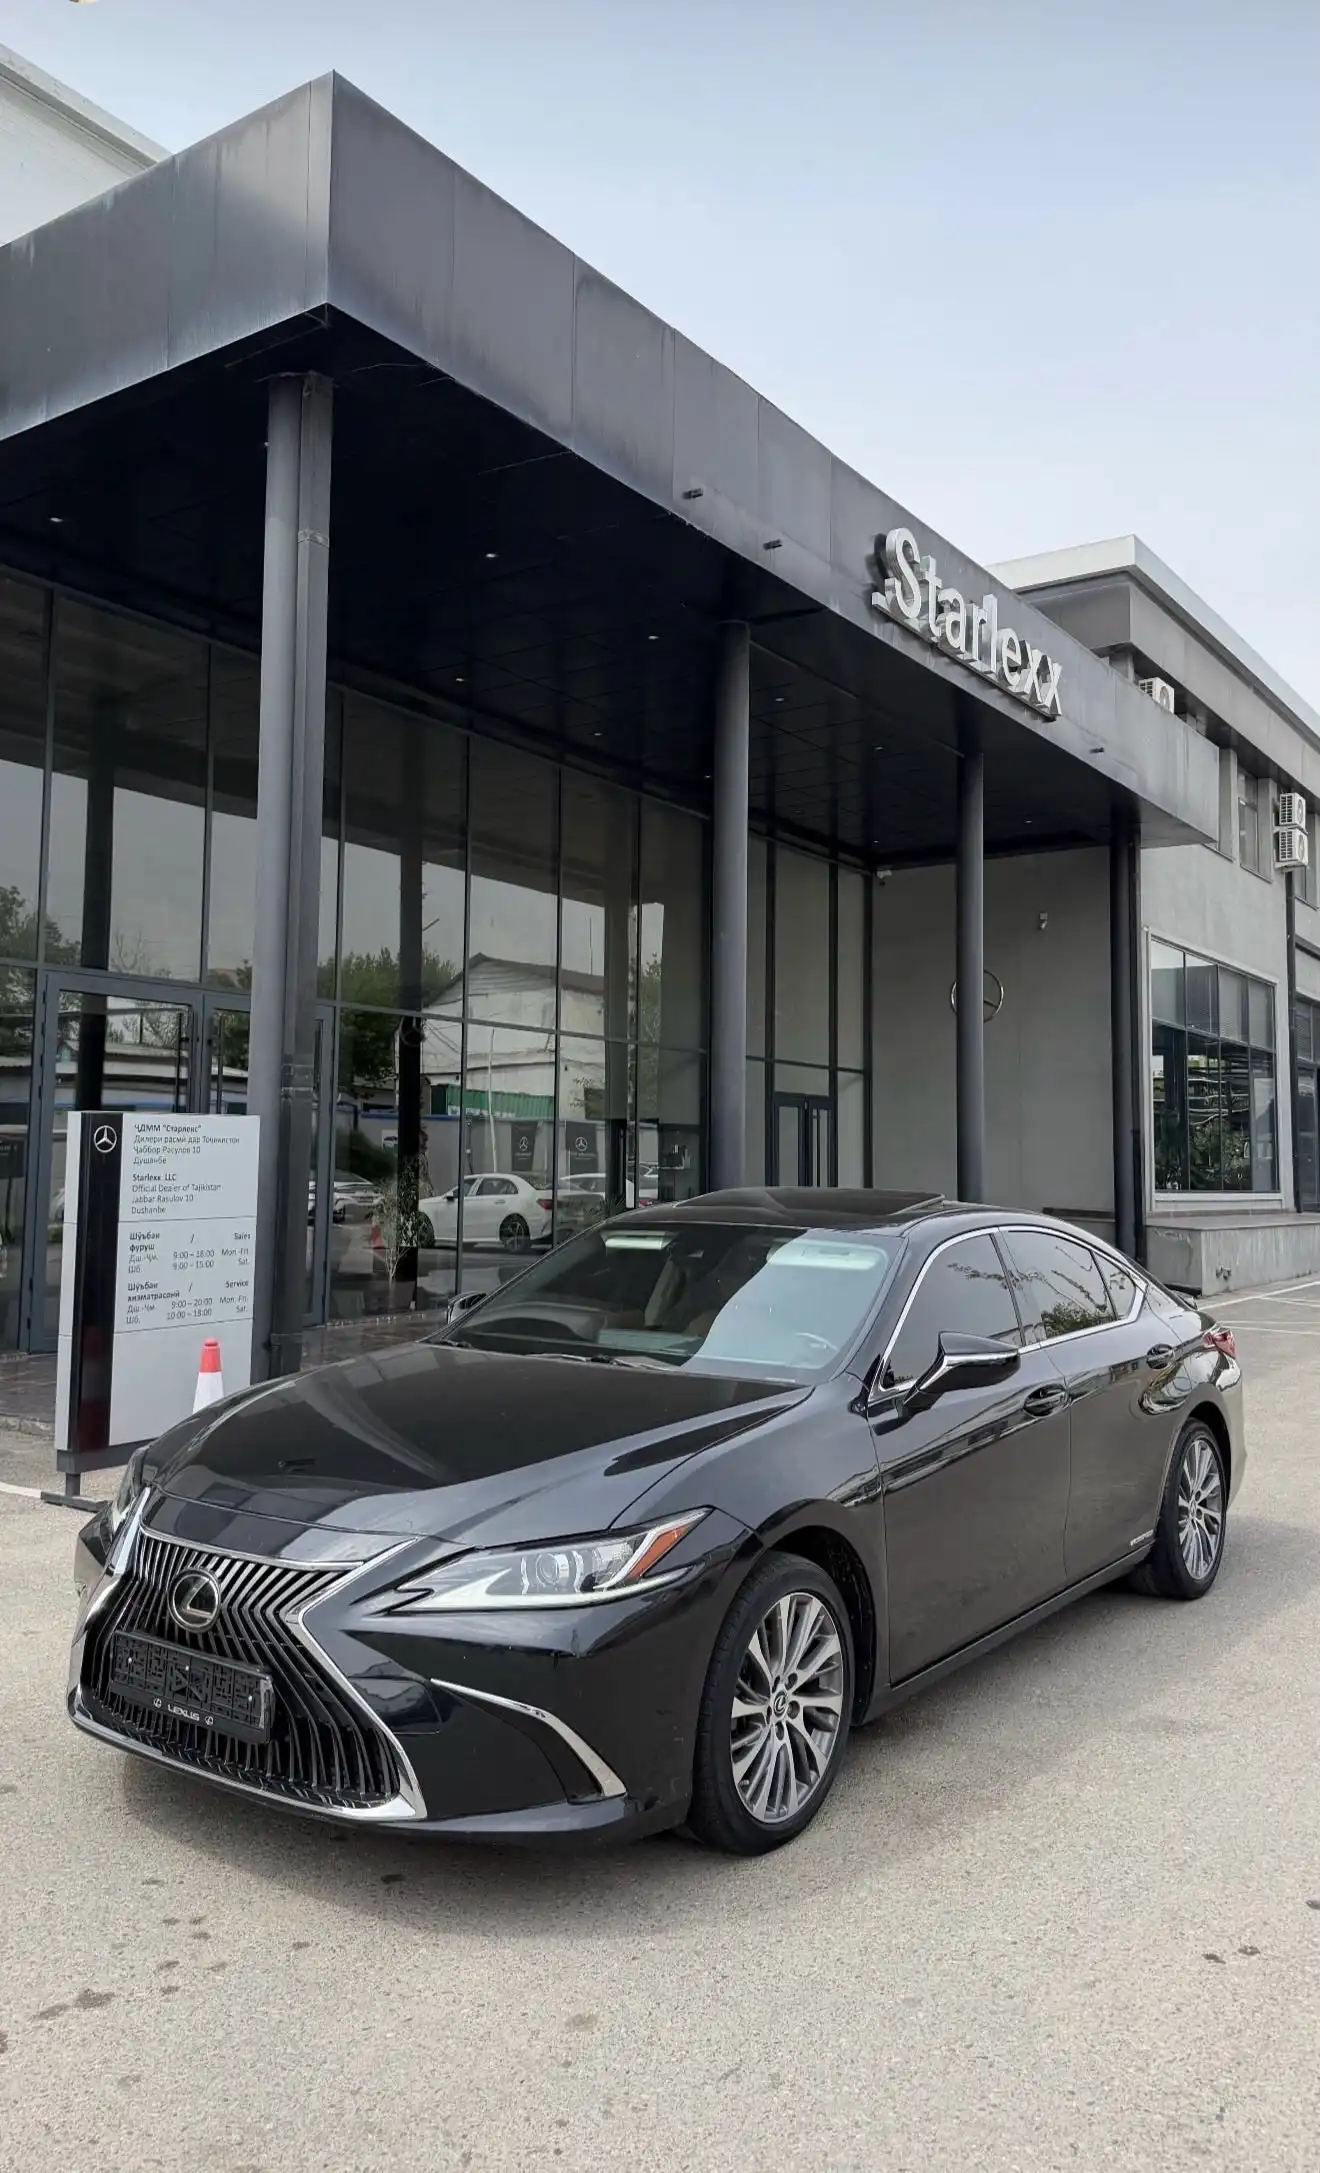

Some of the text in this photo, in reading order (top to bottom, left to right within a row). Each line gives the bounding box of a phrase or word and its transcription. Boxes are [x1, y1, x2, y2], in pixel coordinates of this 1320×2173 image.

[872, 527, 1062, 718] Starlexx
[192, 1146, 201, 1154] 10
[164, 1173, 177, 1182] LLC
[132, 1183, 221, 1193] Official Dealer of Tajikistan
[132, 1194, 194, 1204] Jabbar Rasulov 10
[131, 1205, 166, 1215] Dushanbe
[233, 1232, 251, 1241] Sales
[225, 1280, 249, 1289] Service
[167, 1703, 200, 1722] LEXUS
